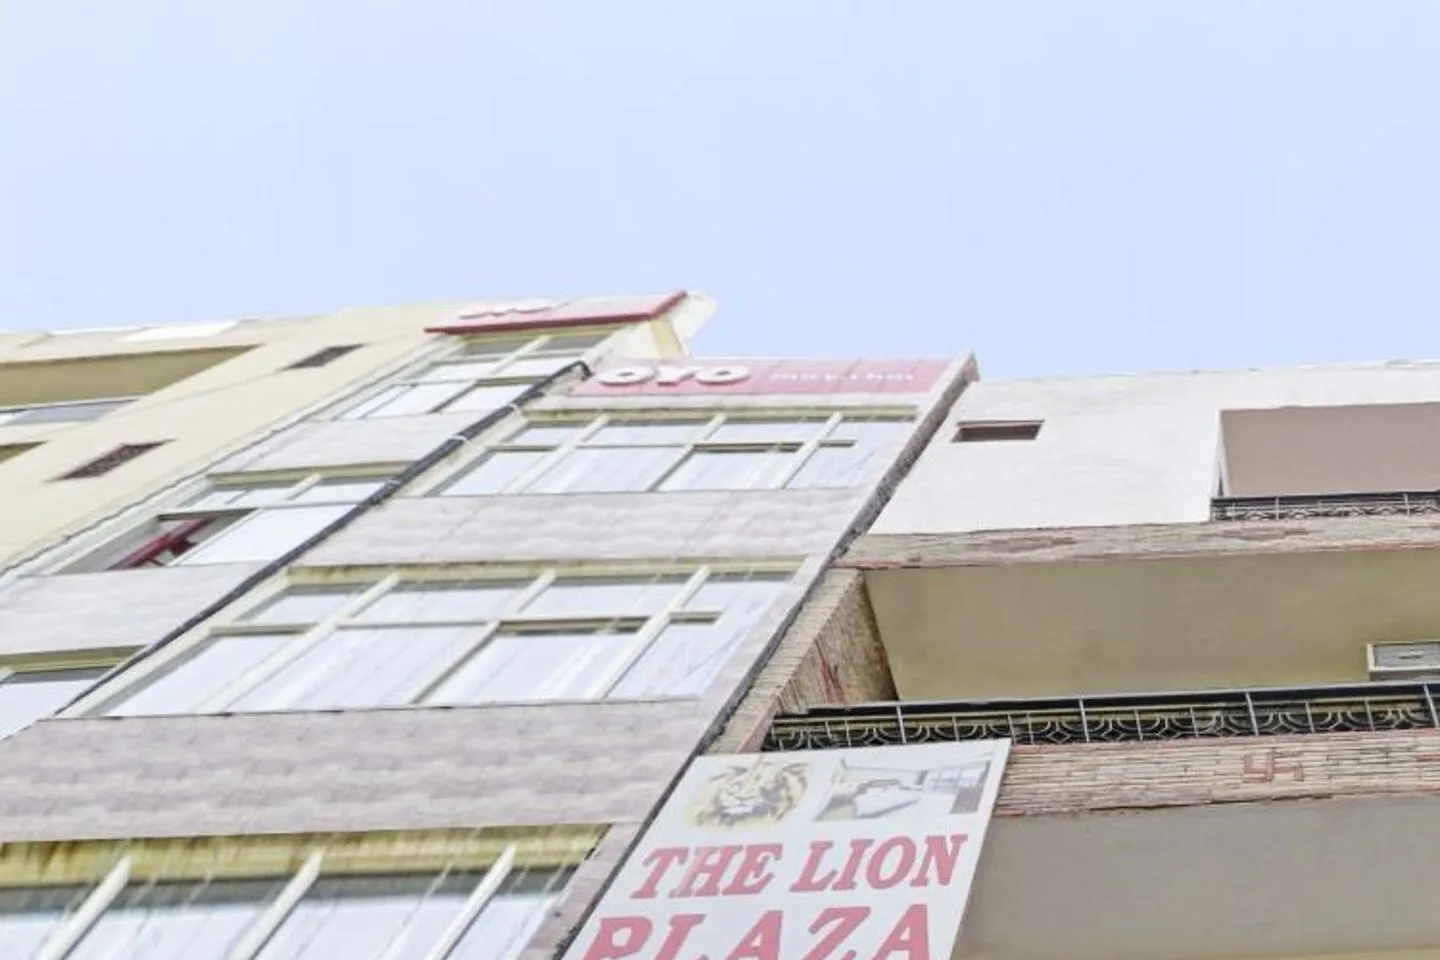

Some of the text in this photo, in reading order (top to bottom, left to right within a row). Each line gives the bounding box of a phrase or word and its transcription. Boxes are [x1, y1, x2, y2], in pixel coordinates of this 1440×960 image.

[599, 364, 751, 386] OYO
[630, 833, 968, 899] THE LION
